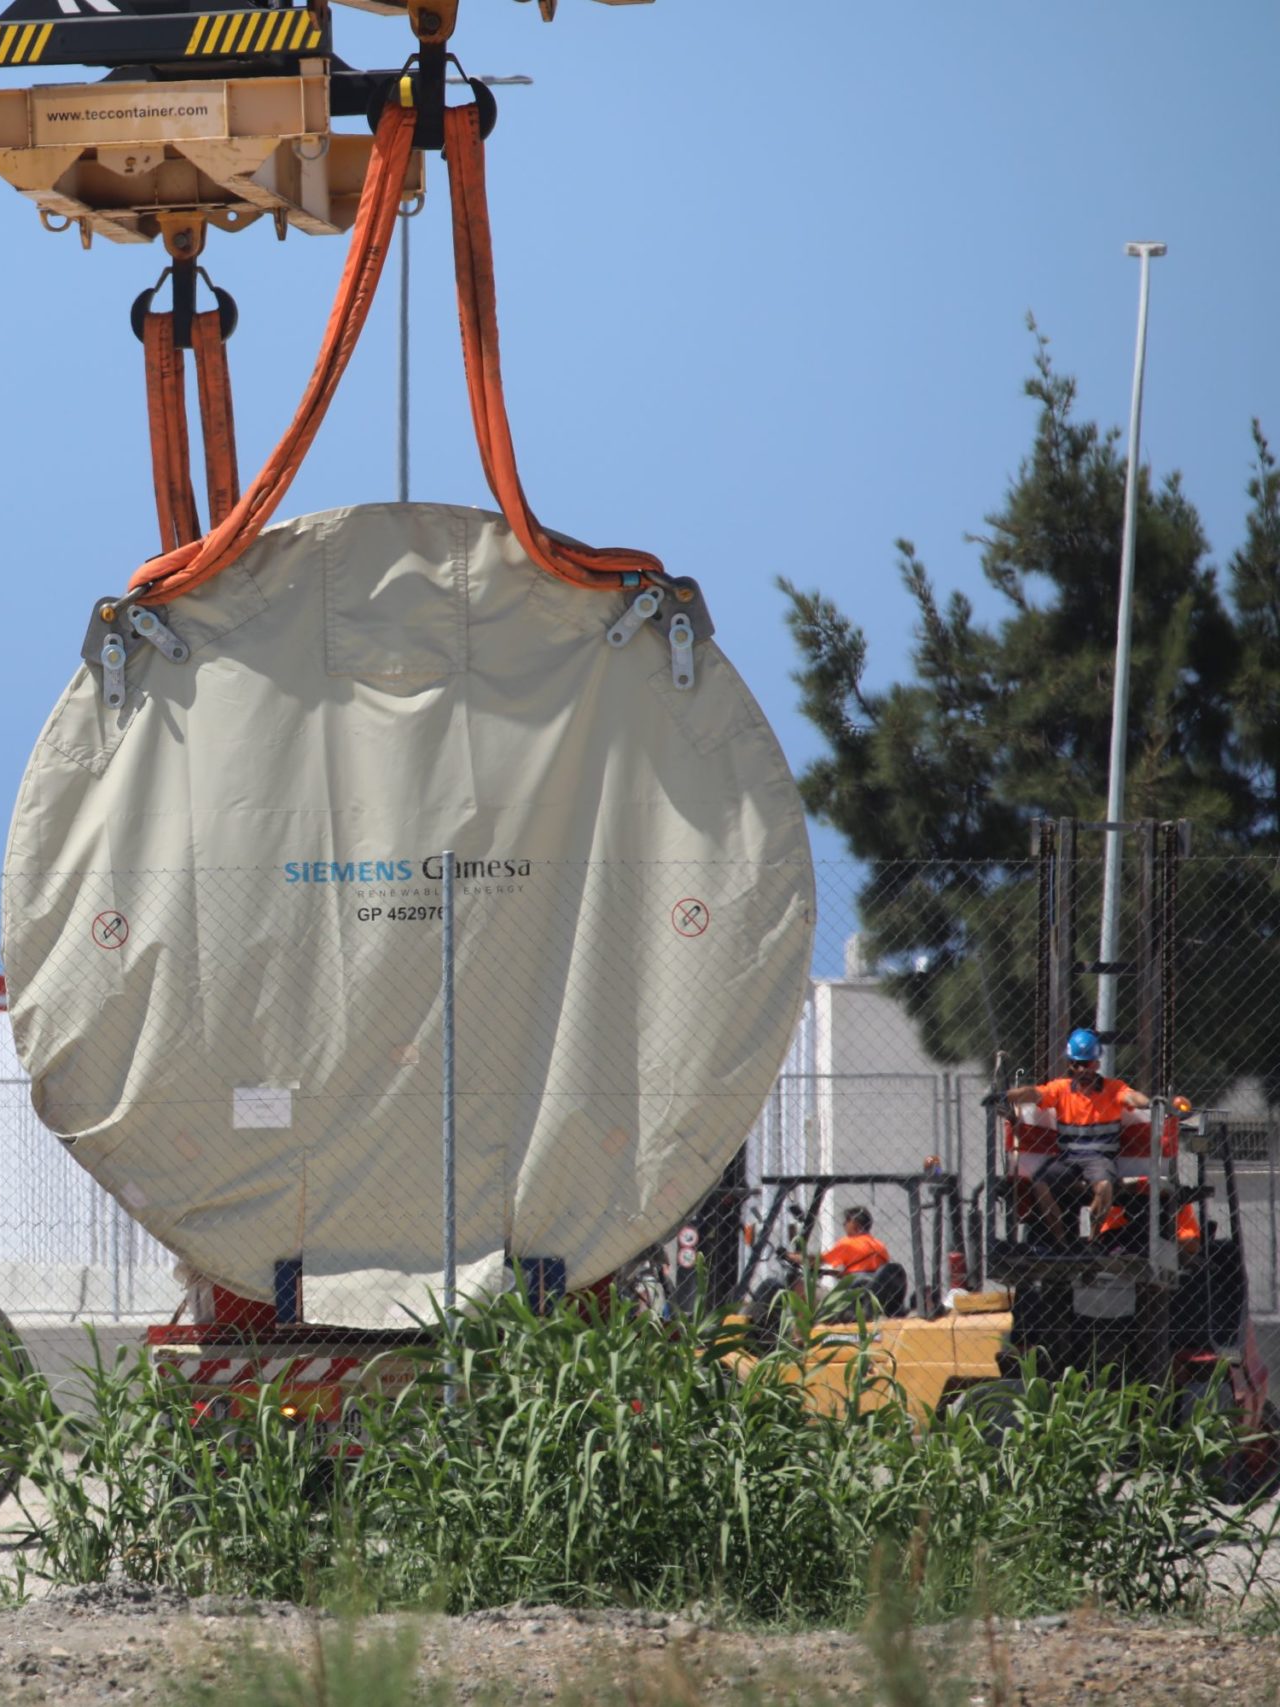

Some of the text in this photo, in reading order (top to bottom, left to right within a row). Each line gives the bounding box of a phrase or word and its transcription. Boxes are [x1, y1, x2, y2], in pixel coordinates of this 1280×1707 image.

[47, 104, 208, 122] www.teccontainer.com
[284, 860, 413, 882] SIEMENS
[357, 885, 524, 898] RENEWABL ENERGY
[357, 907, 383, 921] GP
